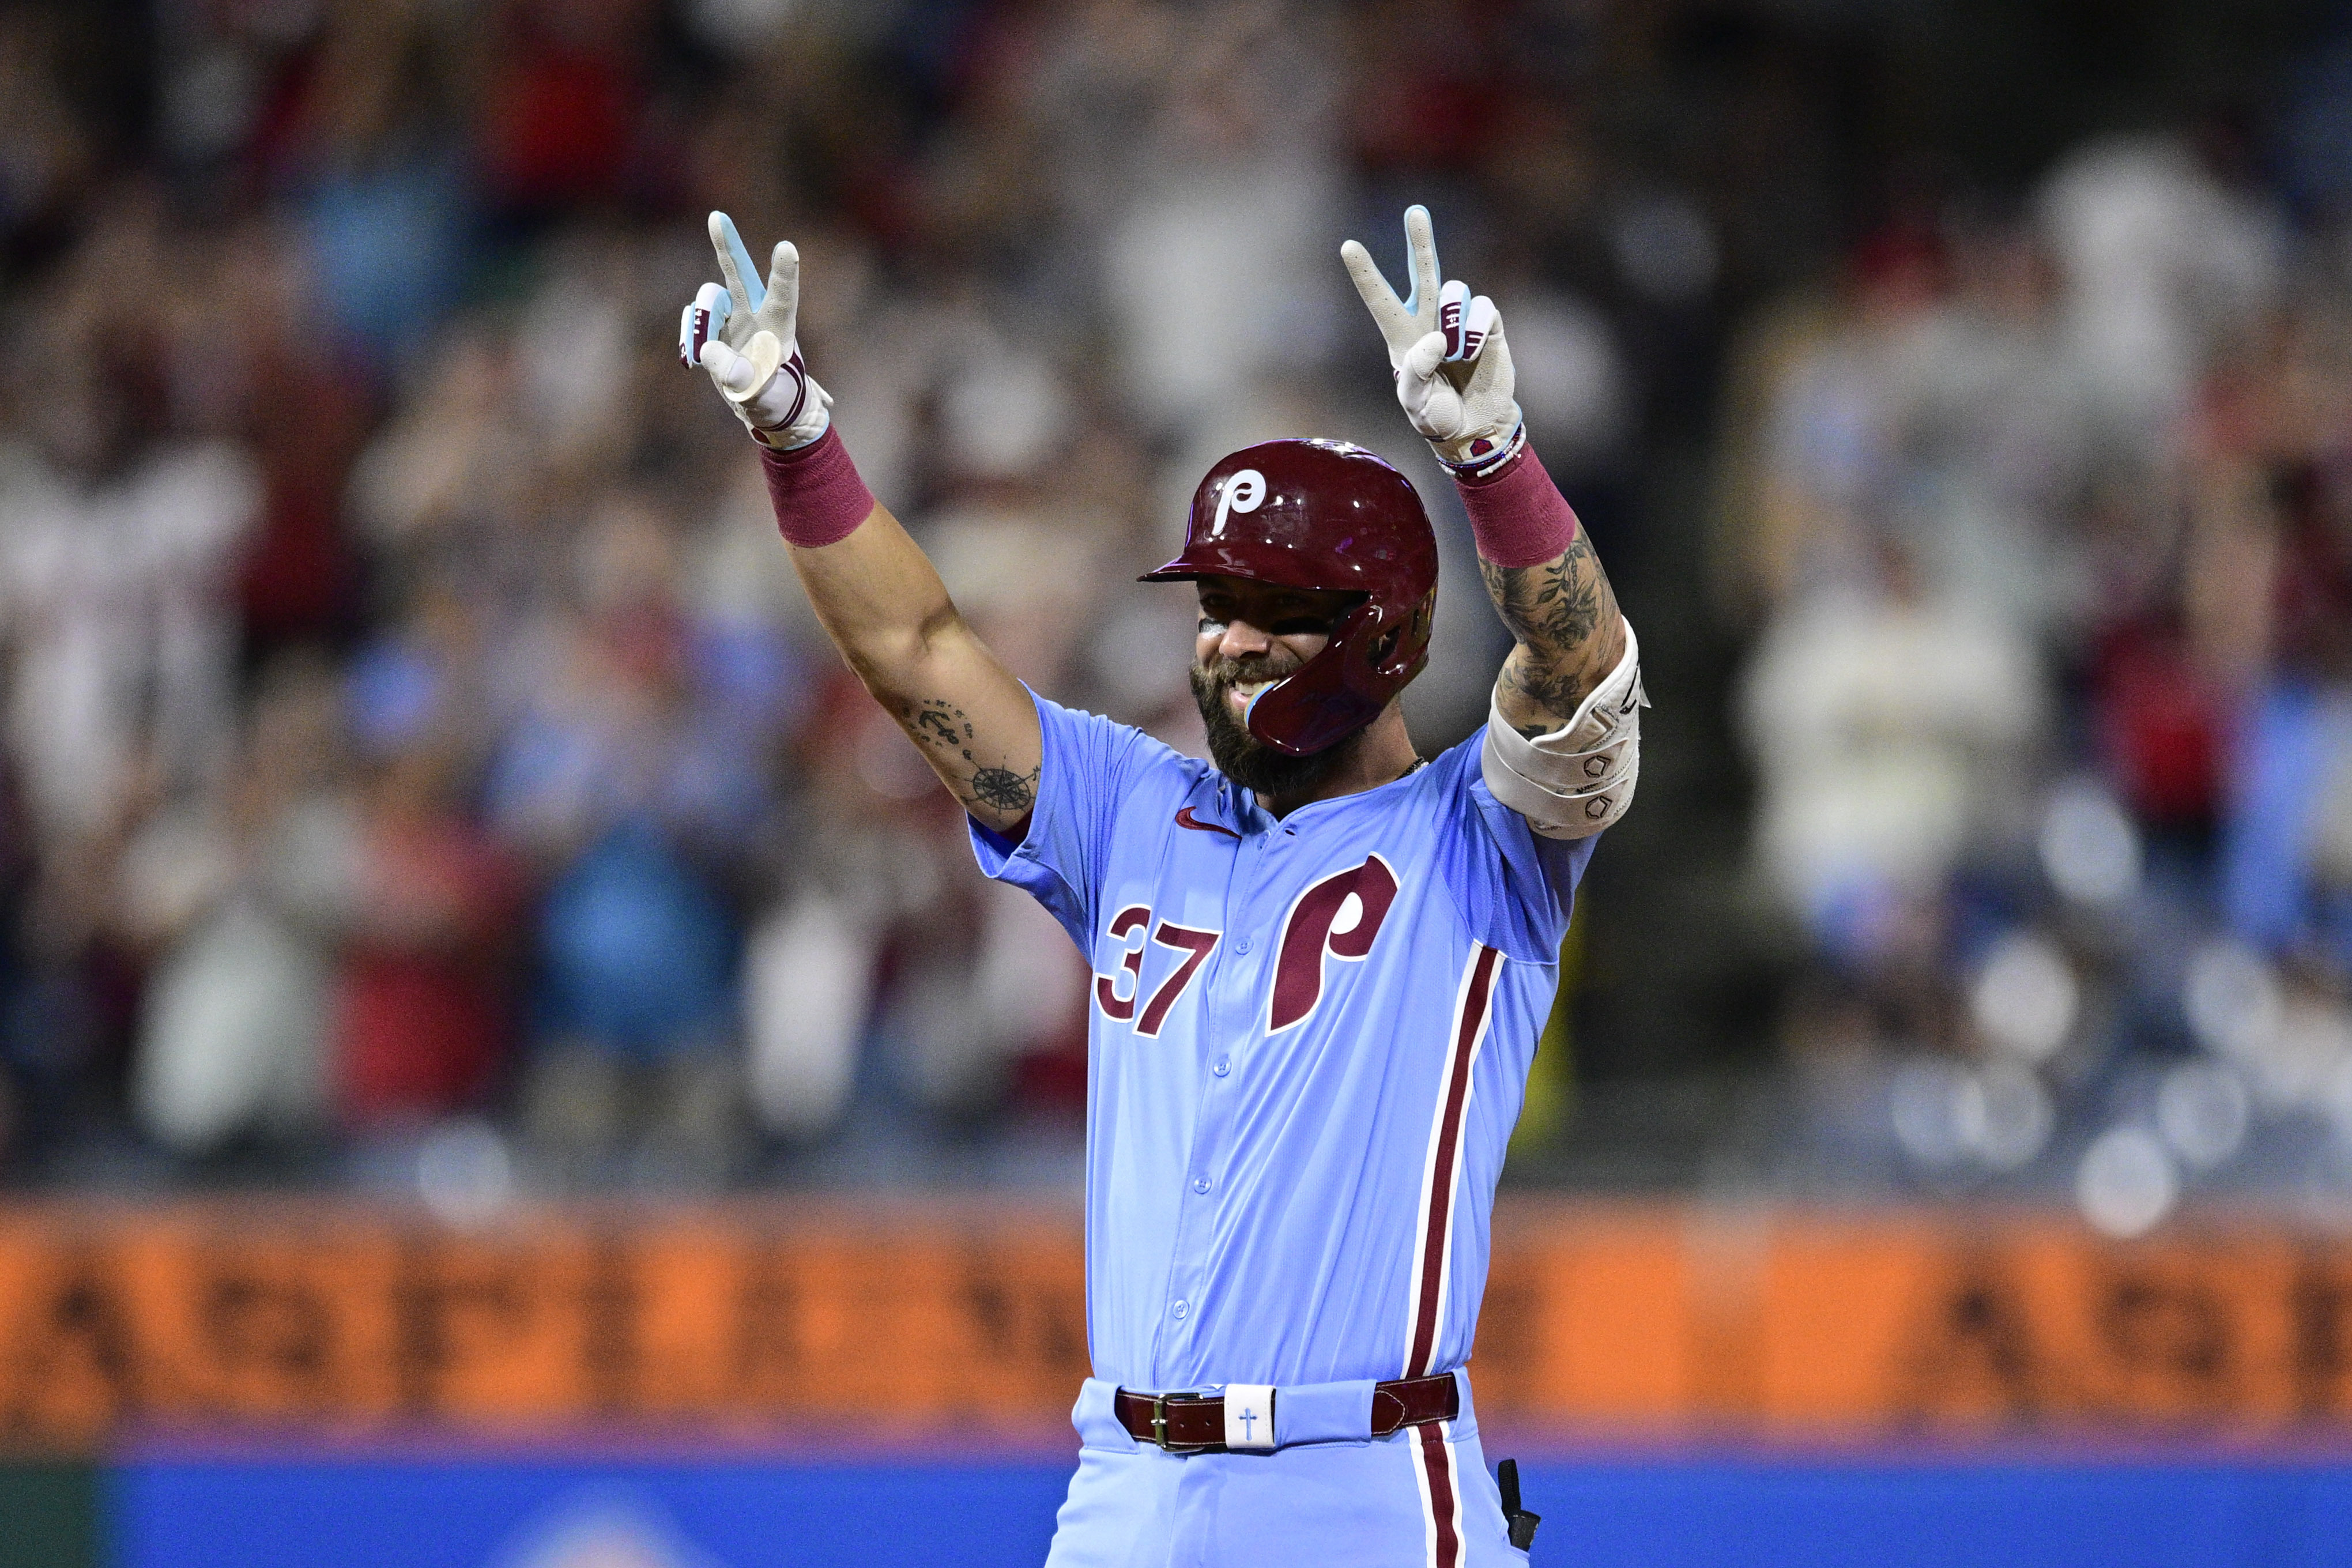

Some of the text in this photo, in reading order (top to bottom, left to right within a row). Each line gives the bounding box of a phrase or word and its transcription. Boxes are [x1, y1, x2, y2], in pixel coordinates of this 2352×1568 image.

[1212, 469, 1267, 536] P
[1094, 903, 1224, 1040] 37
[1264, 851, 1401, 1038] P
